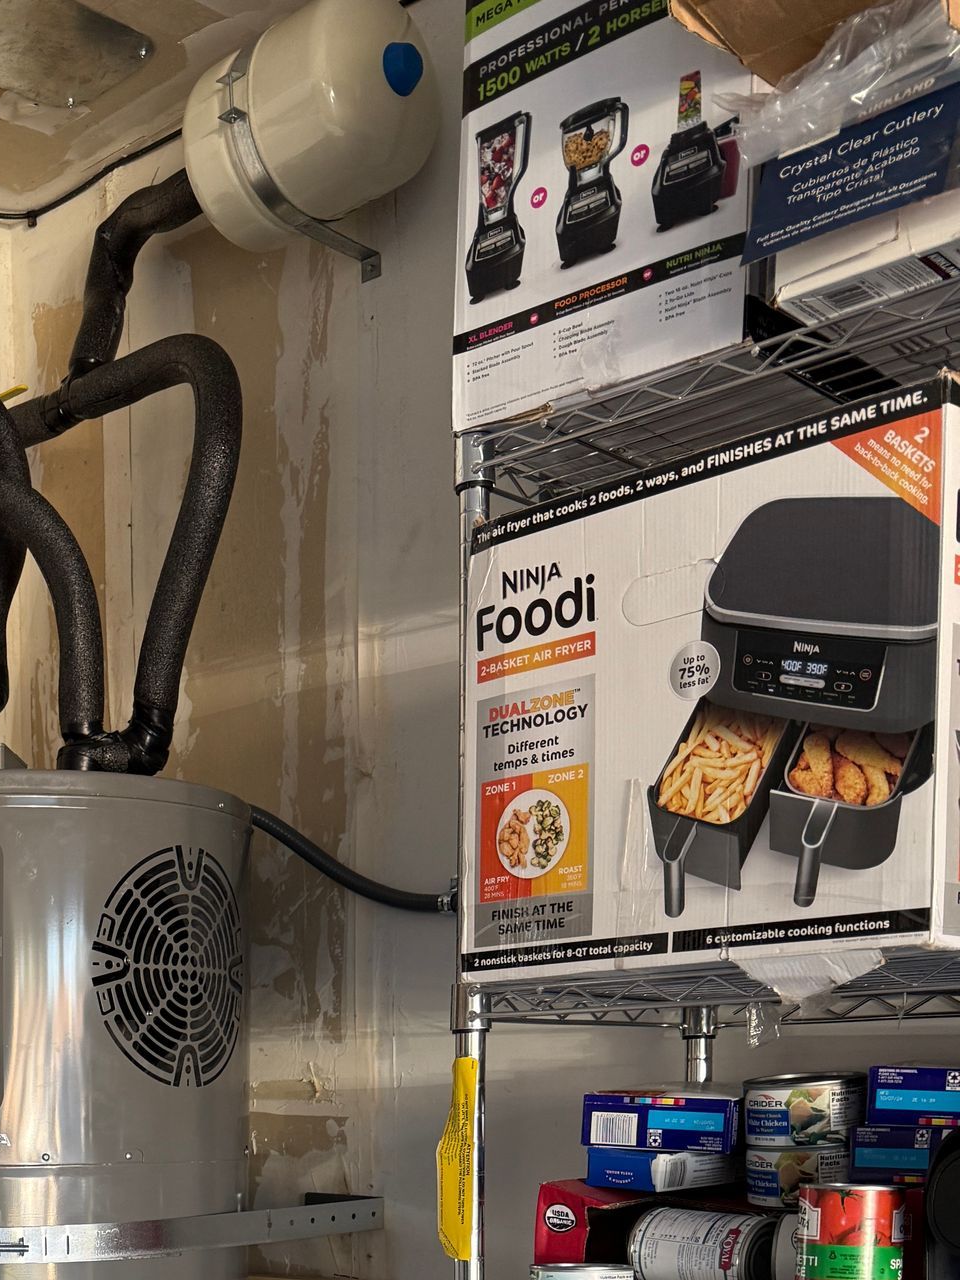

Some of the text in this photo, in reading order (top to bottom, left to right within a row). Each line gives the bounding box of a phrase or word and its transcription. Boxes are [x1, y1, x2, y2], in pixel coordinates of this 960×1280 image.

[475, 1, 514, 27] MEGA
[479, 15, 593, 78] PROFESSIONAL
[477, 66, 521, 101] 1500
[524, 42, 571, 74] WATTS
[587, 26, 601, 47] 2
[779, 103, 944, 180] Crystal Clear Cutlery
[787, 146, 920, 205] Transparente Acabado
[792, 162, 850, 193] Cubiertos
[852, 157, 868, 170] de
[816, 170, 885, 204] Tipo Cristal
[840, 194, 875, 212] Designed
[666, 254, 693, 269] NUTRI
[694, 244, 723, 261] NINJA
[554, 294, 578, 309] FOOD
[579, 276, 628, 303] PROCESSOR
[468, 334, 478, 344] XL
[480, 321, 513, 340] BLENDER
[915, 426, 930, 444] 2
[867, 438, 921, 480] means need
[884, 429, 935, 473] BASKETS
[477, 391, 928, 545] The air fryer that cooks 2 foods, 2 ways, and FINISHES AT THE SAME TIME.
[854, 442, 929, 505] back-to-back cooking.
[502, 561, 562, 599] NINJA
[477, 573, 595, 651] Foodi
[481, 640, 592, 677] 2-BASKET AIR FRYER
[683, 655, 695, 667] Up
[793, 641, 820, 655] NINJA
[679, 663, 710, 680] 75%
[781, 660, 828, 675] 400F 390F
[680, 680, 696, 690] less
[483, 704, 588, 738] TECHNOLOGY
[508, 735, 559, 755] Different
[493, 748, 575, 772] temps & times
[485, 784, 510, 796] ZONE
[548, 771, 575, 784] ZONE
[558, 865, 583, 875] ROAST
[491, 901, 573, 921] FINISH AT THE
[498, 917, 565, 935] SAME TIME
[714, 928, 785, 944] customizable
[787, 924, 832, 939] cooking
[835, 918, 890, 933] functions
[481, 940, 653, 966] nonstick baskets 8-QT total capacity
[551, 1209, 570, 1218] USDA
